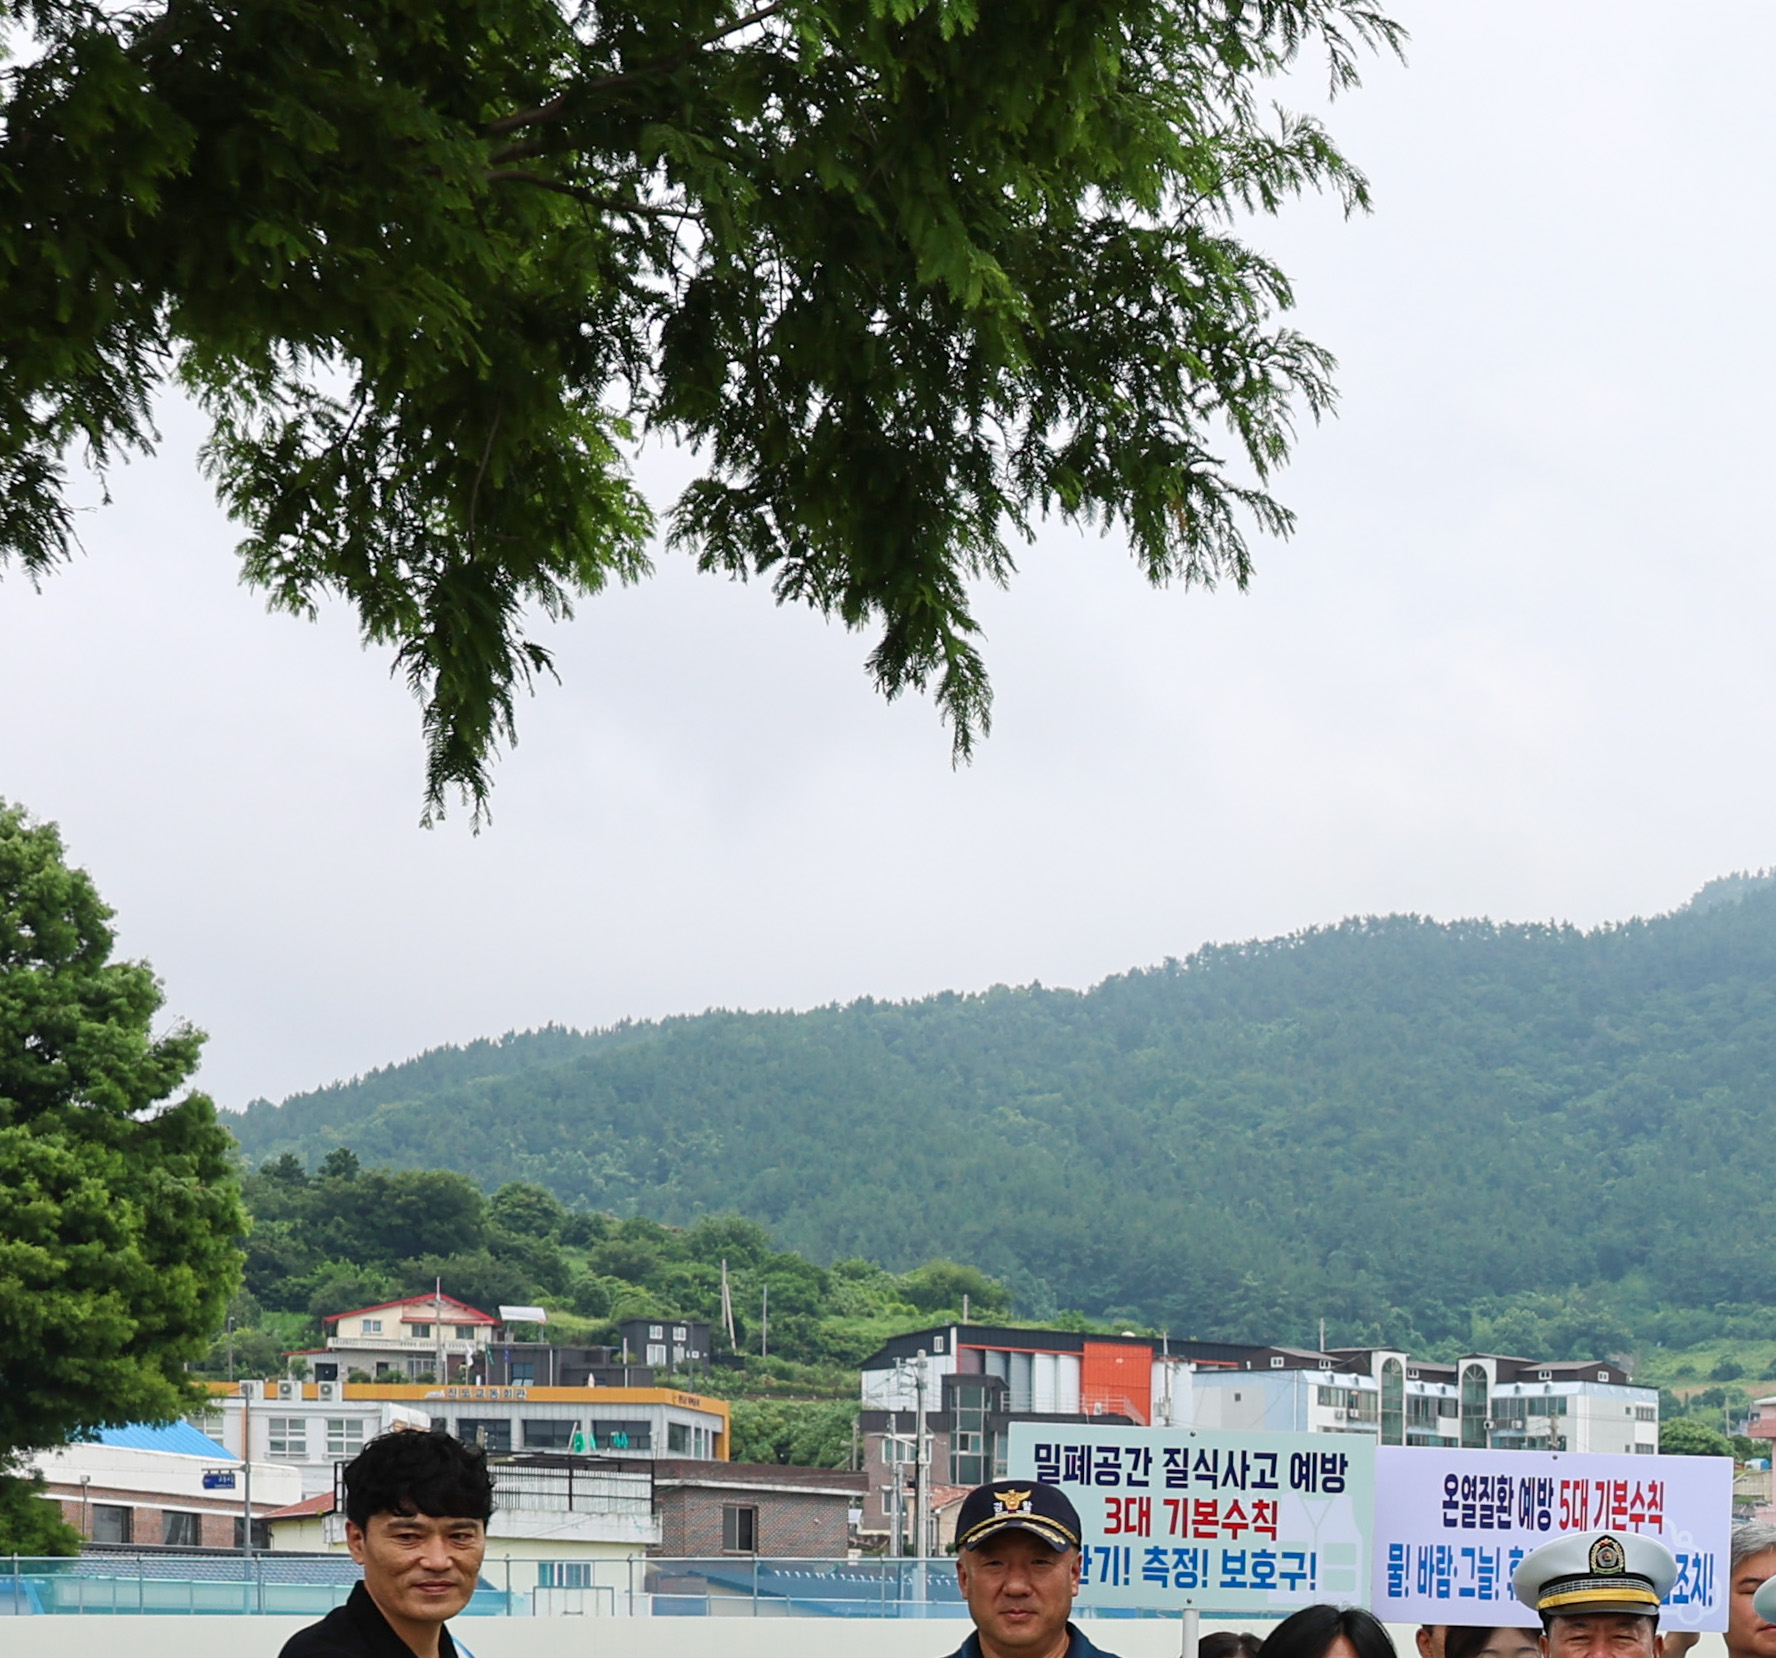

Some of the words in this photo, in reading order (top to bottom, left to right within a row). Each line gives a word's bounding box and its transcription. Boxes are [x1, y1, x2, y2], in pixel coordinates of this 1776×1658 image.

[1034, 1443, 1152, 1488] 밀폐공간
[1163, 1447, 1279, 1490] 질식사고
[1290, 1451, 1348, 1493] 예방
[1104, 1497, 1151, 1537] 3대
[1163, 1499, 1278, 1541] 기본수칙
[1442, 1474, 1514, 1529] 온열질환
[1519, 1477, 1554, 1531] 예방
[1559, 1479, 1588, 1531] 5대
[1594, 1480, 1665, 1534] 기본수칙
[1141, 1548, 1208, 1589] 측정!
[1220, 1550, 1316, 1591] 보호구!
[1387, 1543, 1410, 1598] 물!
